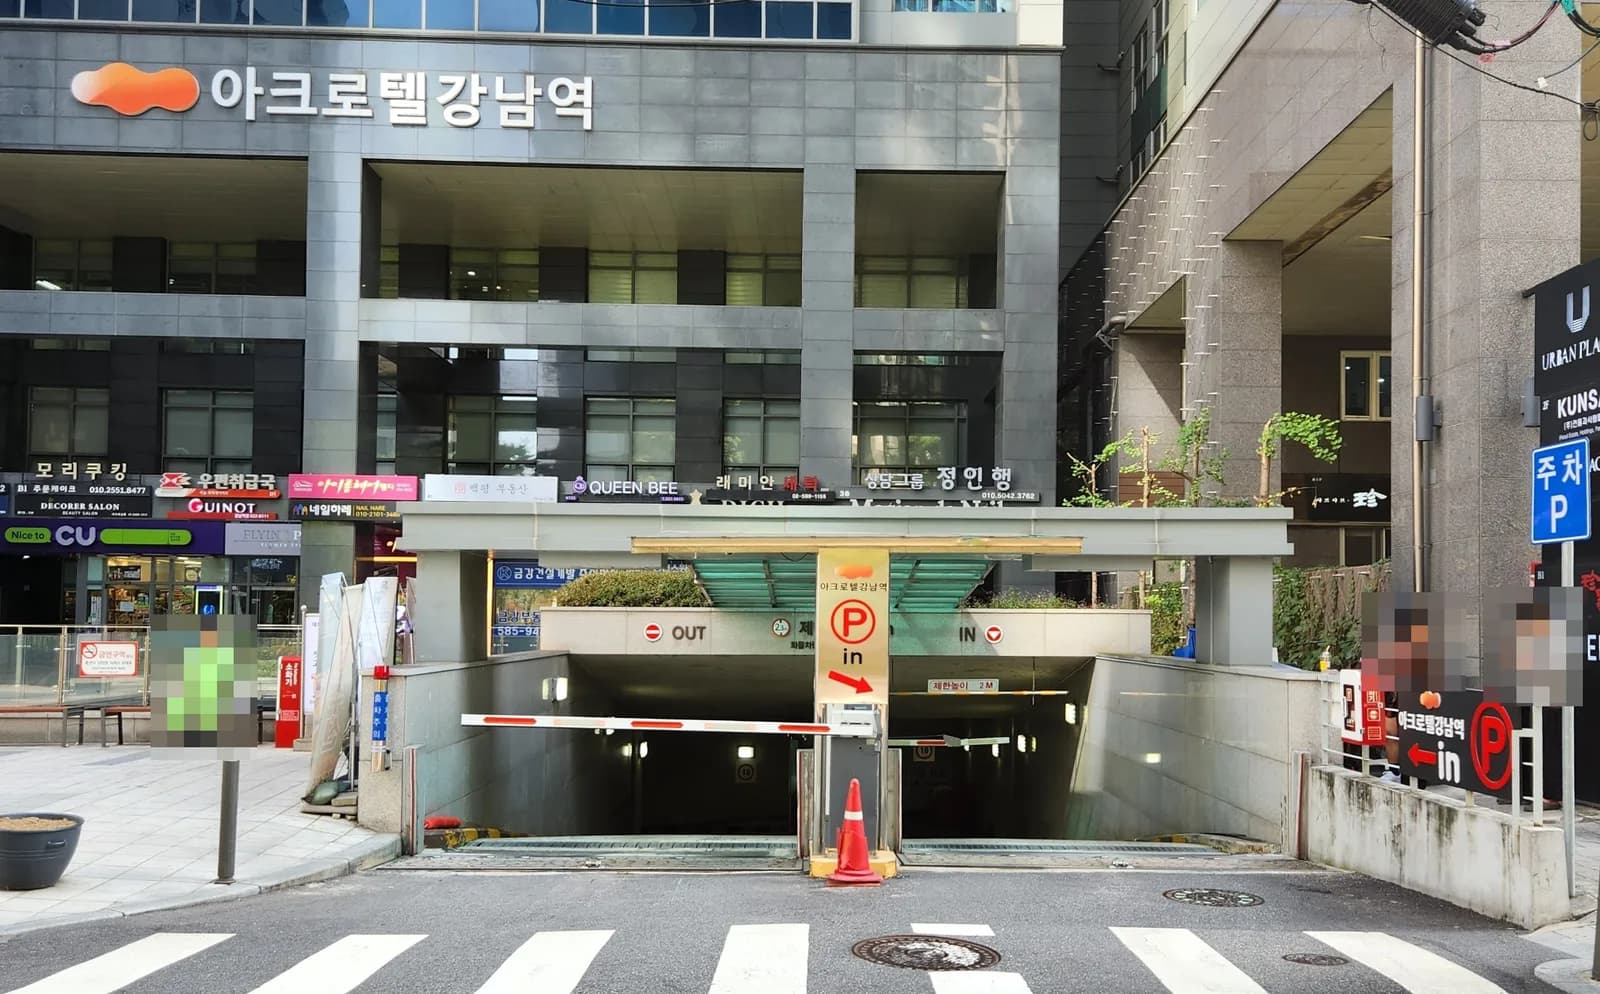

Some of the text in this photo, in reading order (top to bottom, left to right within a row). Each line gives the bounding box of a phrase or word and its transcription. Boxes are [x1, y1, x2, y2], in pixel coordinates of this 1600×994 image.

[210, 66, 593, 130] 아크로텔강남역
[1542, 343, 1577, 371] URBAN
[1557, 388, 1600, 419] KUNS
[36, 462, 127, 481] 모리쿠킹
[936, 466, 1012, 491] 정인행
[1537, 449, 1584, 491] 주차
[197, 473, 276, 491] 우편취급국
[589, 481, 678, 495] QUEEN BEE
[715, 475, 775, 491] 래미안
[188, 498, 256, 513] GUINOT
[1551, 494, 1568, 534] P
[11, 525, 97, 547] Nice to CU
[513, 567, 575, 580] 금강건설개발
[819, 582, 888, 593] 아크로텔강남역
[672, 626, 707, 640] OUT
[843, 607, 867, 637] P
[959, 627, 976, 642] IN
[843, 648, 863, 664] in
[1397, 710, 1465, 741] 아크로텔강남역
[1481, 715, 1506, 775] P
[1437, 740, 1460, 784] in
